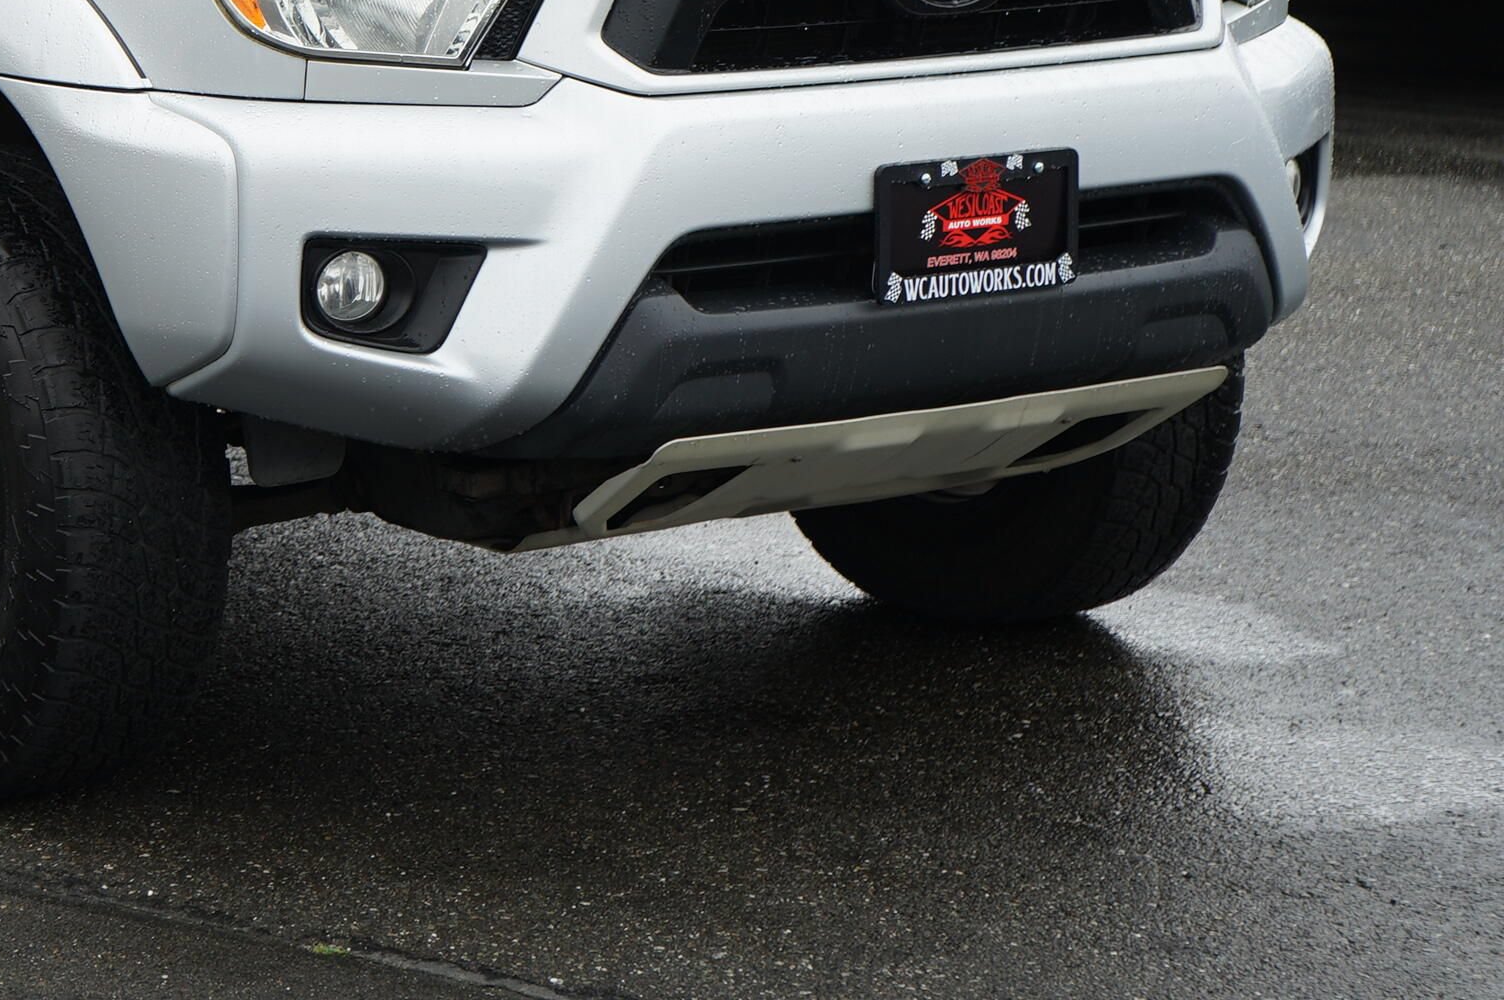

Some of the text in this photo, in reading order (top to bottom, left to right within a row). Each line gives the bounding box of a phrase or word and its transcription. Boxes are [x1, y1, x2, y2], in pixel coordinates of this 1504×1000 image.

[948, 216, 1002, 230] AUTO WORKS
[926, 252, 972, 268] EVERETT,
[974, 250, 990, 262] WA
[904, 262, 1057, 302] WCAUTOWORKS.COM
